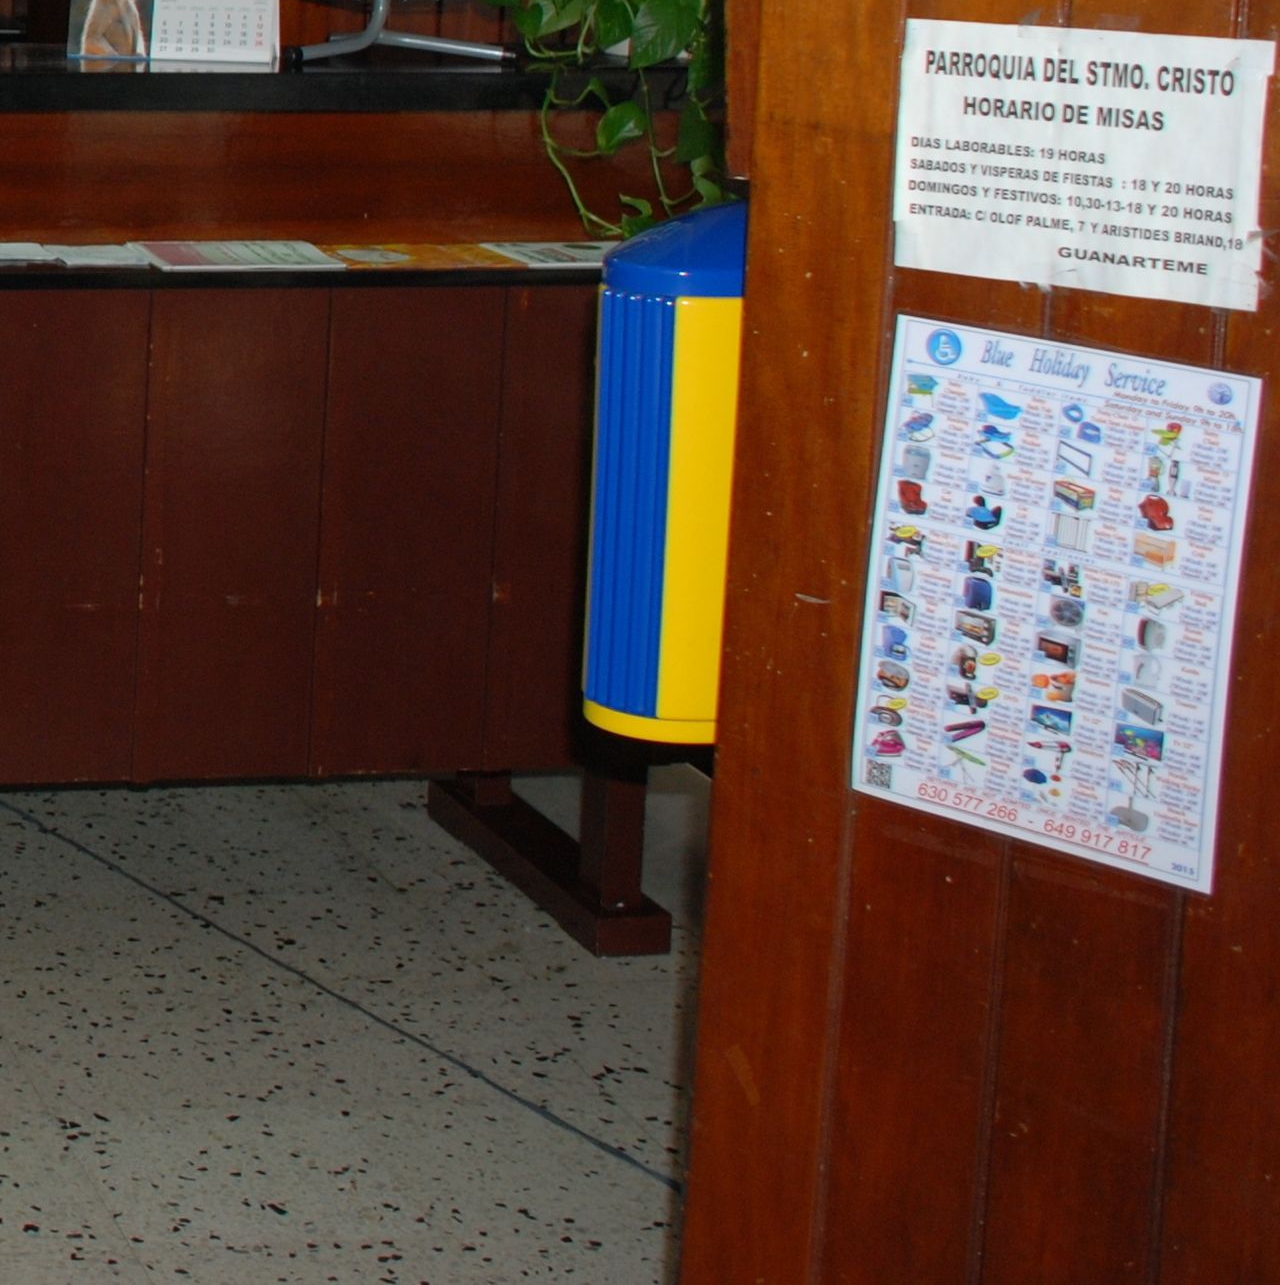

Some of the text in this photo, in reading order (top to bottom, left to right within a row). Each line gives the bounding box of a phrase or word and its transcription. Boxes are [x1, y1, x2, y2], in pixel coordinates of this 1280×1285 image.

[924, 50, 1235, 96] PARROQUIA DEL STMO. CRISTO
[963, 96, 1164, 131] HORARIO DE MISAS
[911, 136, 1106, 165] DIAS LABORABLES: 19 HORAS
[910, 158, 965, 174] SABADOS
[970, 163, 978, 174] Y
[981, 165, 1039, 181] VISPERAS
[1043, 171, 1059, 183] DE
[1062, 172, 1113, 189] FIESTAS
[1131, 179, 1146, 191] 18
[1151, 180, 1160, 192] Y
[1165, 183, 1181, 195] 20
[1185, 184, 1234, 200] HORAS
[908, 180, 1232, 224] DOMINGOS Y FESTIVOS: 10,30-13-18 Y 20 HORAS
[909, 203, 972, 221] ENTRADA:
[990, 211, 1022, 226] OLOF
[1026, 216, 1074, 234] PALME,
[1078, 220, 1085, 232] 7
[1091, 222, 1099, 234] Y
[1101, 223, 1169, 242] ARISTIDES
[1174, 232, 1244, 252] BRIAND,18
[1057, 246, 1209, 276] GUANARTEME
[980, 339, 1167, 397] Blue Holiday Service
[1104, 400, 1142, 416] Saturday
[1146, 408, 1161, 418] and
[1165, 412, 1196, 426] Sunday
[1214, 420, 1222, 429] to
[1114, 391, 1148, 404] Monday
[1162, 399, 1189, 413] Friday
[1207, 408, 1216, 416] to
[918, 782, 948, 802] 630
[953, 792, 984, 811] 577
[987, 802, 1018, 822] 266
[1043, 819, 1076, 839] 649
[1081, 829, 1113, 849] 917
[1117, 840, 1152, 860] 817
